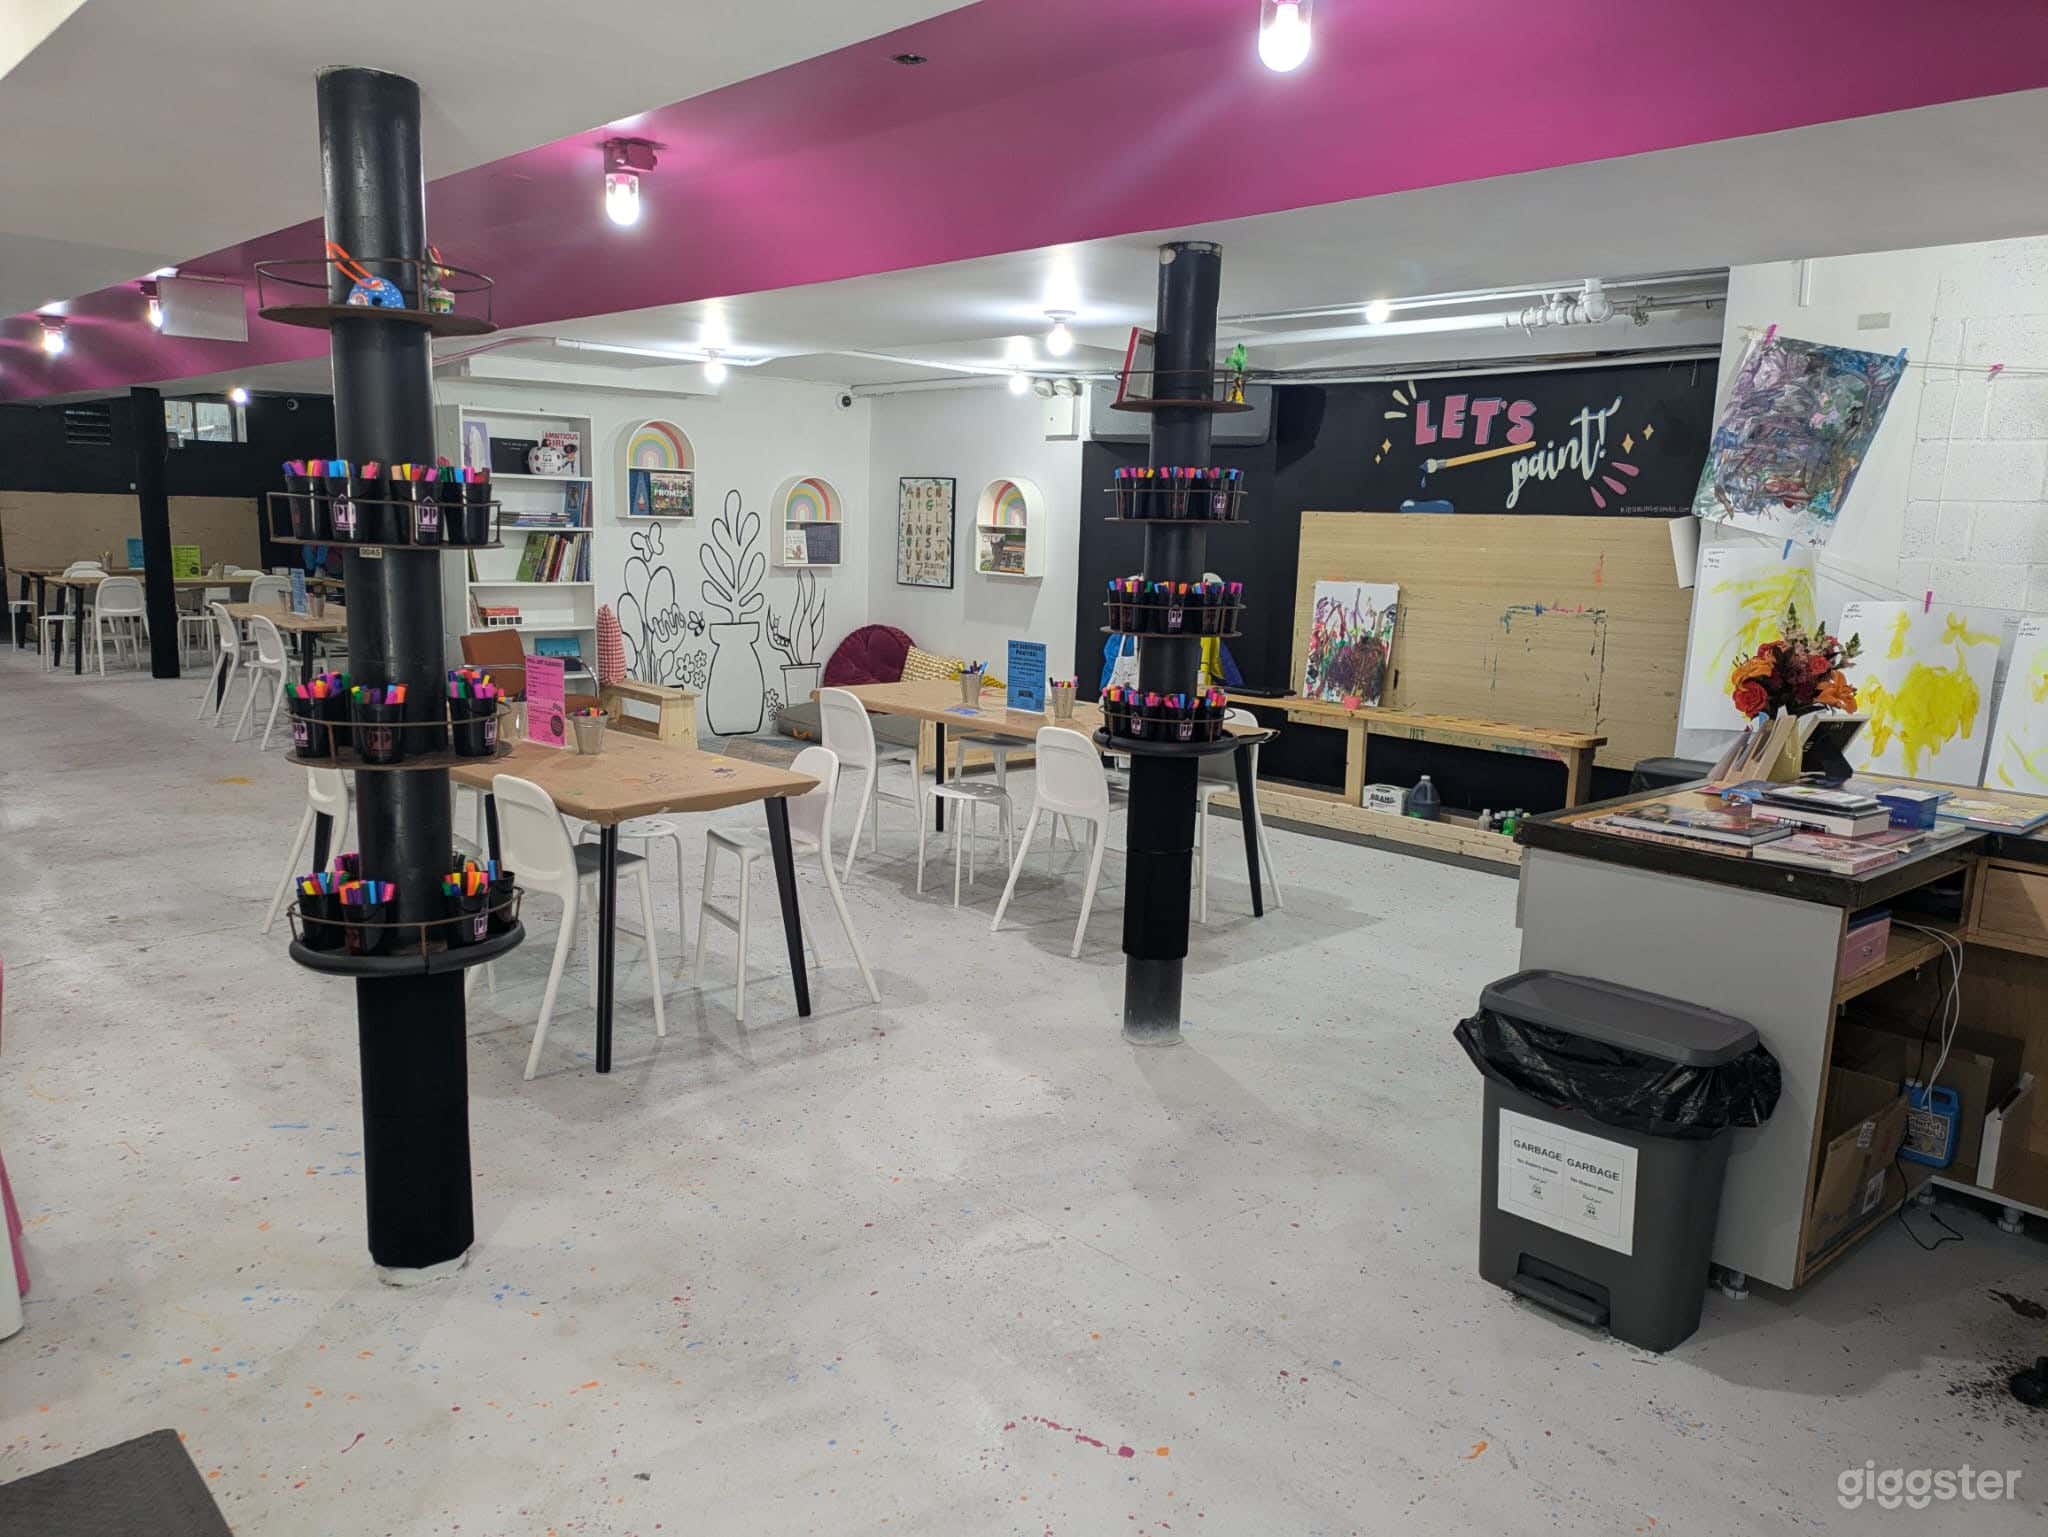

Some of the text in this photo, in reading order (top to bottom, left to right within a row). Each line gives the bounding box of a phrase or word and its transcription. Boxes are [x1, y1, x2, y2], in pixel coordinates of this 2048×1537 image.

[1415, 394, 1537, 445] LET'S
[1505, 395, 1623, 509] paint!
[1512, 1138, 1563, 1163] GARBAGE
[1566, 1158, 1621, 1182] GARBAGE
